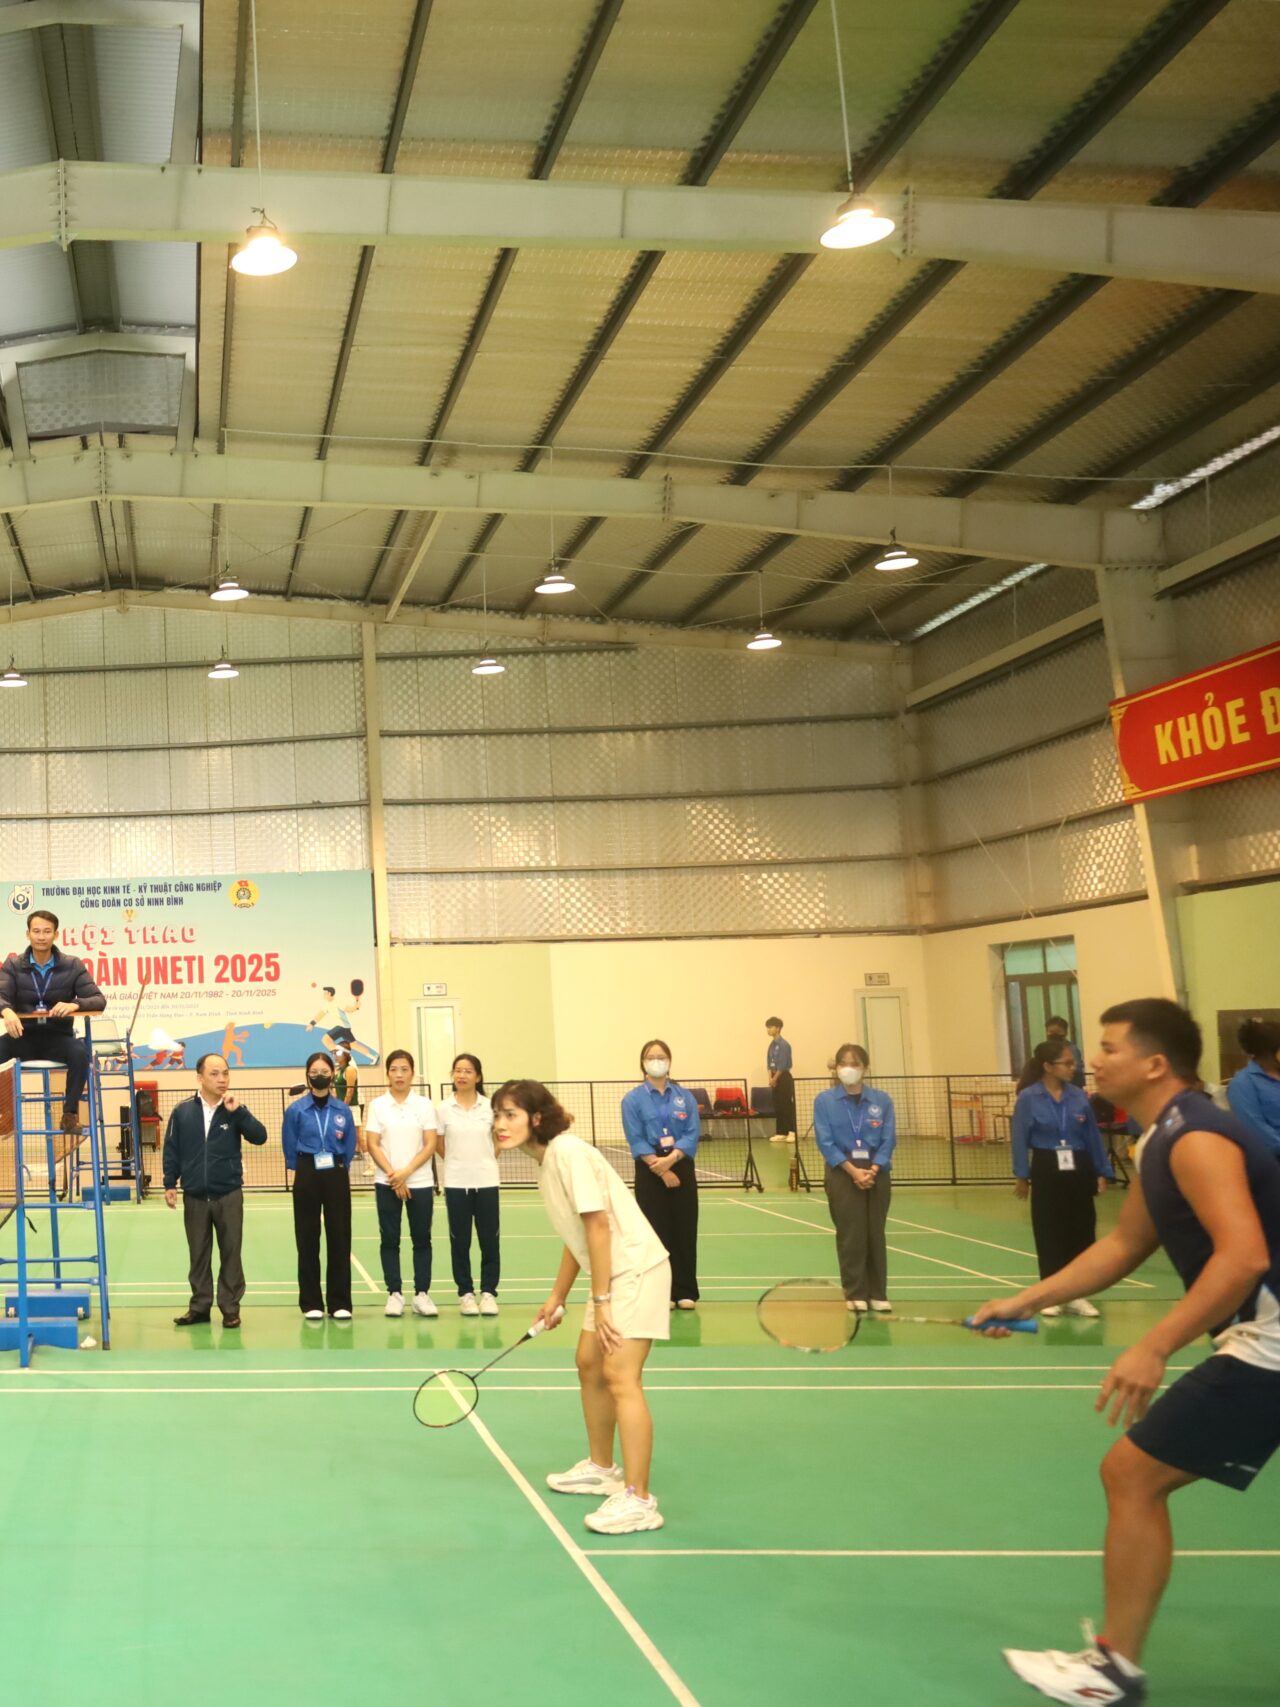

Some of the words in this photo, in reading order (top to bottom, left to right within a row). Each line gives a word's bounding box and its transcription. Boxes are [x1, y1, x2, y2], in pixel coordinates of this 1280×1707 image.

[1154, 692, 1251, 765] KHỎE
[42, 885, 70, 896] TRƯỜNG
[72, 886, 84, 897] ĐẠI
[86, 886, 101, 897] HỌC
[103, 885, 120, 895] KINH
[122, 883, 131, 894] TẾ
[138, 883, 148, 894] KỸ
[150, 882, 172, 894] THUẬT
[174, 881, 194, 893] CÔNG
[196, 880, 222, 893] NGHIỆP
[80, 897, 100, 908] CÔNG
[101, 897, 121, 907] ĐOÀN
[123, 898, 133, 907] CƠ
[147, 897, 164, 906] NINH
[166, 895, 183, 905] BÌNH
[137, 955, 204, 986] UNETI
[214, 953, 280, 984] 2025
[119, 991, 139, 1001] GIÁO
[160, 991, 178, 999] NAM
[180, 990, 224, 999] 20/11/1982
[231, 988, 277, 998] 20/11/2025
